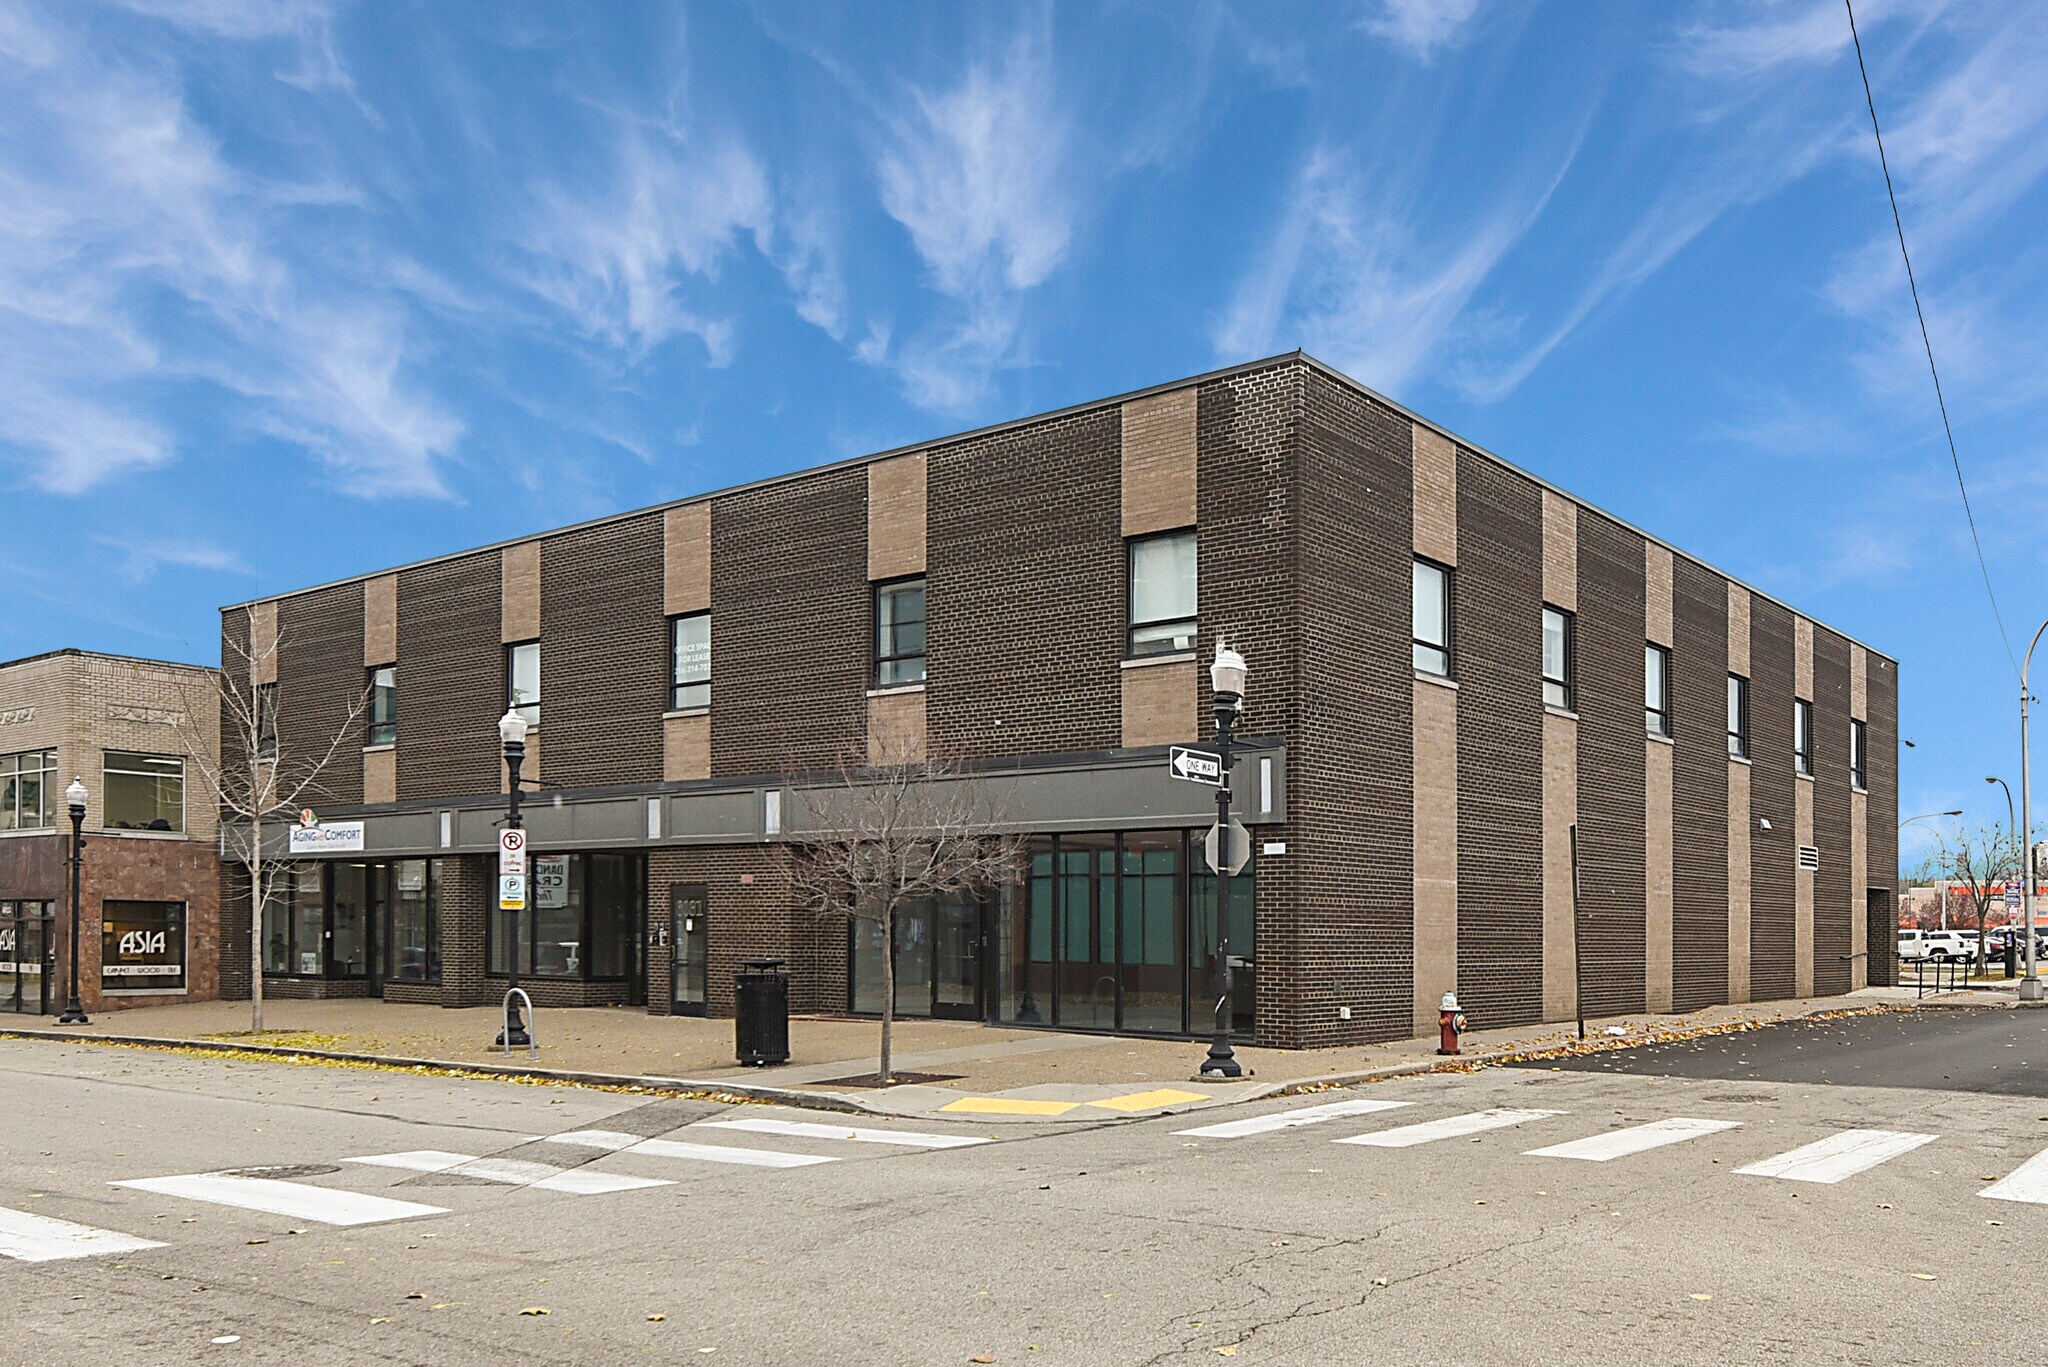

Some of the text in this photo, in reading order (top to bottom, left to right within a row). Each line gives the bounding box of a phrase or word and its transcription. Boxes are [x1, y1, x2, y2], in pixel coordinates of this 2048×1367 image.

[679, 655, 691, 663] FOR
[1186, 759, 1216, 774] ONE WAY
[292, 831, 317, 843] AGING
[324, 829, 361, 840] COMFORT
[119, 930, 166, 954] ASIA
